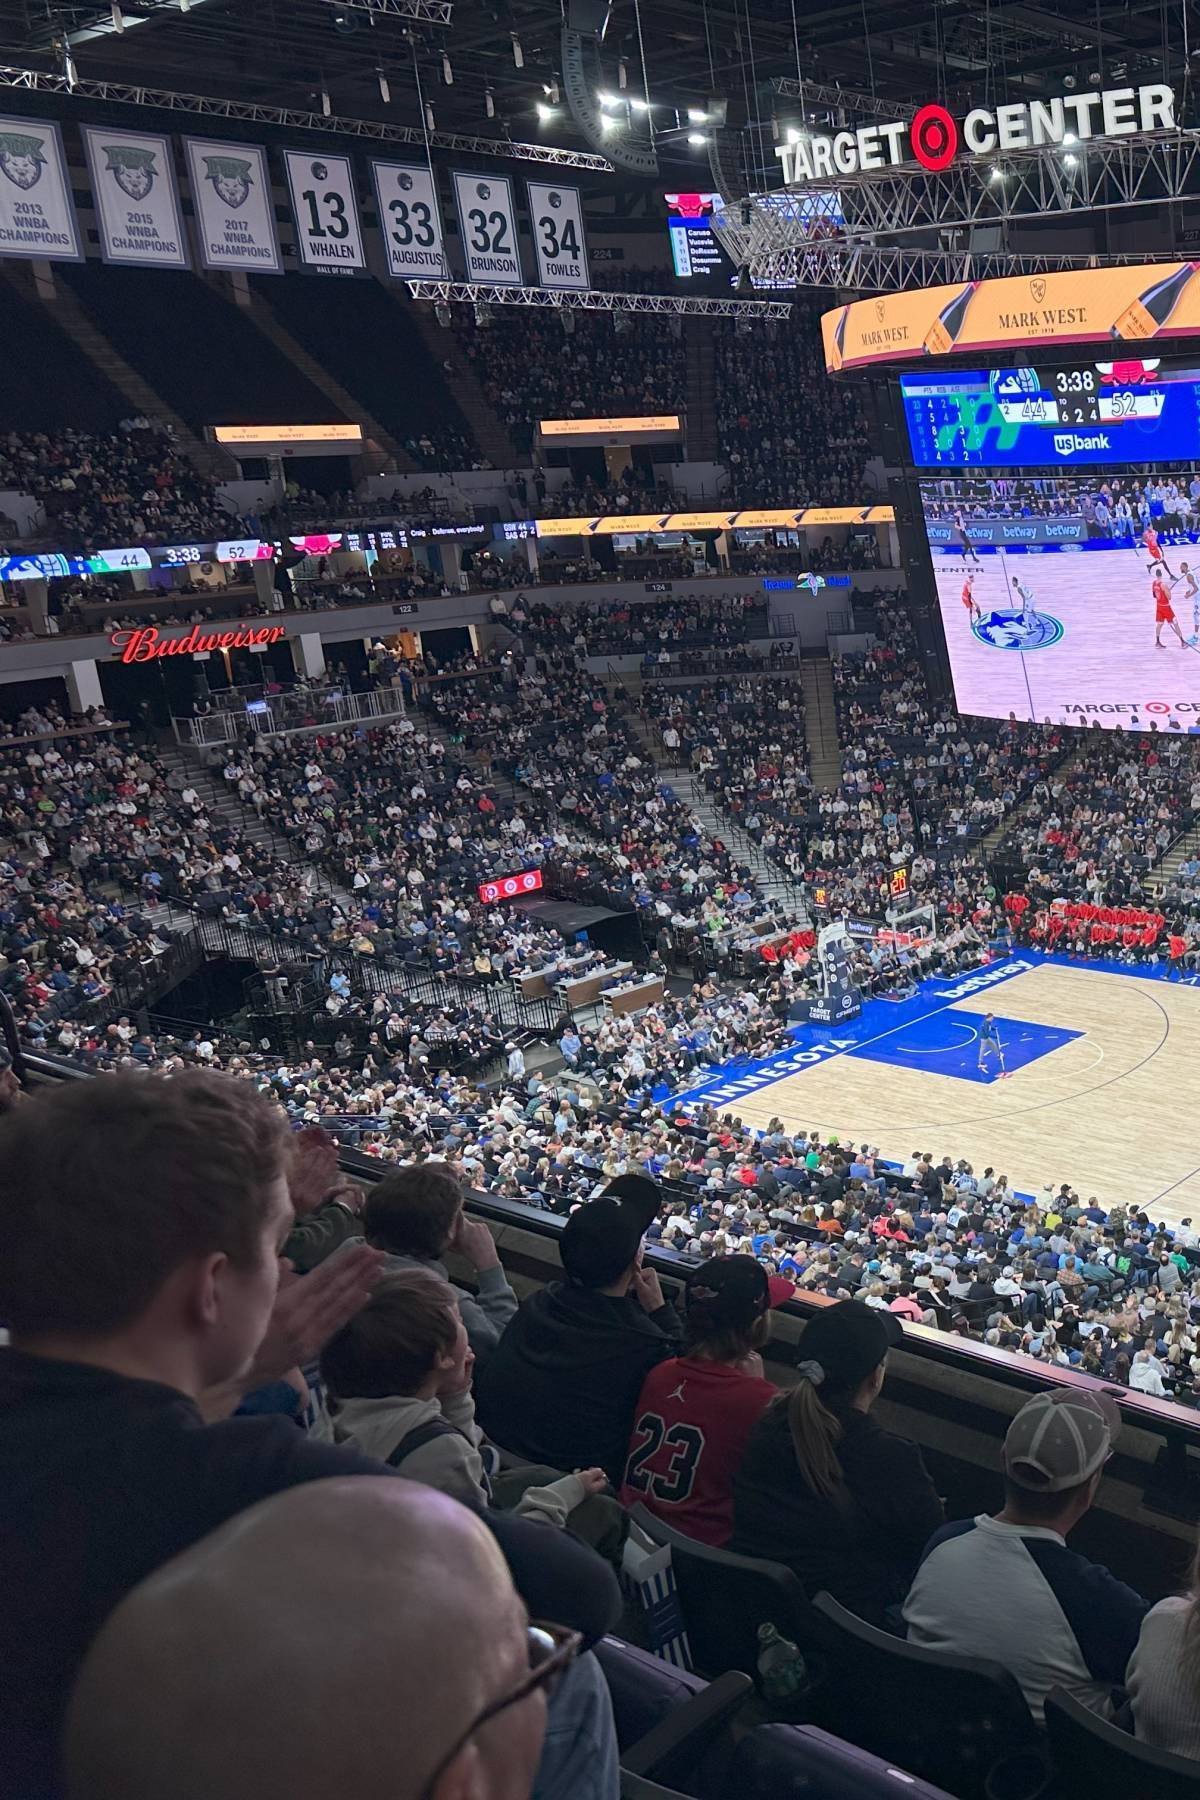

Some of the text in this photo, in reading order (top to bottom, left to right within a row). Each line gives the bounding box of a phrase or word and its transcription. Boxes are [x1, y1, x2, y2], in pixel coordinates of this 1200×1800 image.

[774, 84, 1177, 184] TARGET CENTER
[14, 202, 43, 216] 2013
[302, 190, 349, 239] 13
[13, 216, 50, 230] WNBA
[127, 212, 153, 225] 2015
[224, 219, 248, 232] 2017
[388, 199, 435, 247] 33
[0, 229, 70, 245] CHAMPIONS
[125, 225, 160, 239] WNBA
[223, 232, 255, 245] WNBA
[468, 208, 511, 254] 32
[538, 216, 580, 260] 34
[1184, 231, 1199, 241] 227
[112, 237, 177, 253] CHAMPIONS
[210, 243, 272, 258] CHAMPIONS
[309, 242, 355, 259] WHALEN
[392, 249, 443, 266] AUGUSTUS
[593, 249, 612, 260] 224
[471, 256, 517, 273] BRUNSON
[546, 263, 581, 278] FOWLES
[999, 312, 1040, 329] MARK
[861, 331, 883, 346] MARK
[1056, 371, 1095, 392] 3:38
[1004, 406, 1010, 415] 2
[1022, 398, 1046, 420] 44
[1111, 391, 1137, 417] 52
[1061, 409, 1097, 422] 6 2 4
[504, 523, 517, 531] GSW
[927, 525, 1081, 541] etway betway betway
[505, 531, 528, 540] SAS 47
[167, 548, 201, 563] 3:38
[229, 547, 245, 559] 52
[121, 555, 138, 567] 44
[651, 584, 666, 592] 124
[399, 604, 413, 613] 122
[111, 623, 286, 664] Budweiser
[1061, 704, 1141, 714] TARGET
[891, 879, 906, 894] 20
[848, 921, 873, 933] betway
[934, 959, 1034, 1000] betway
[809, 1006, 831, 1015] TARGET
[809, 1013, 831, 1021] CENTER
[683, 1037, 859, 1115] MINNESOTA
[625, 1411, 706, 1505] 23
